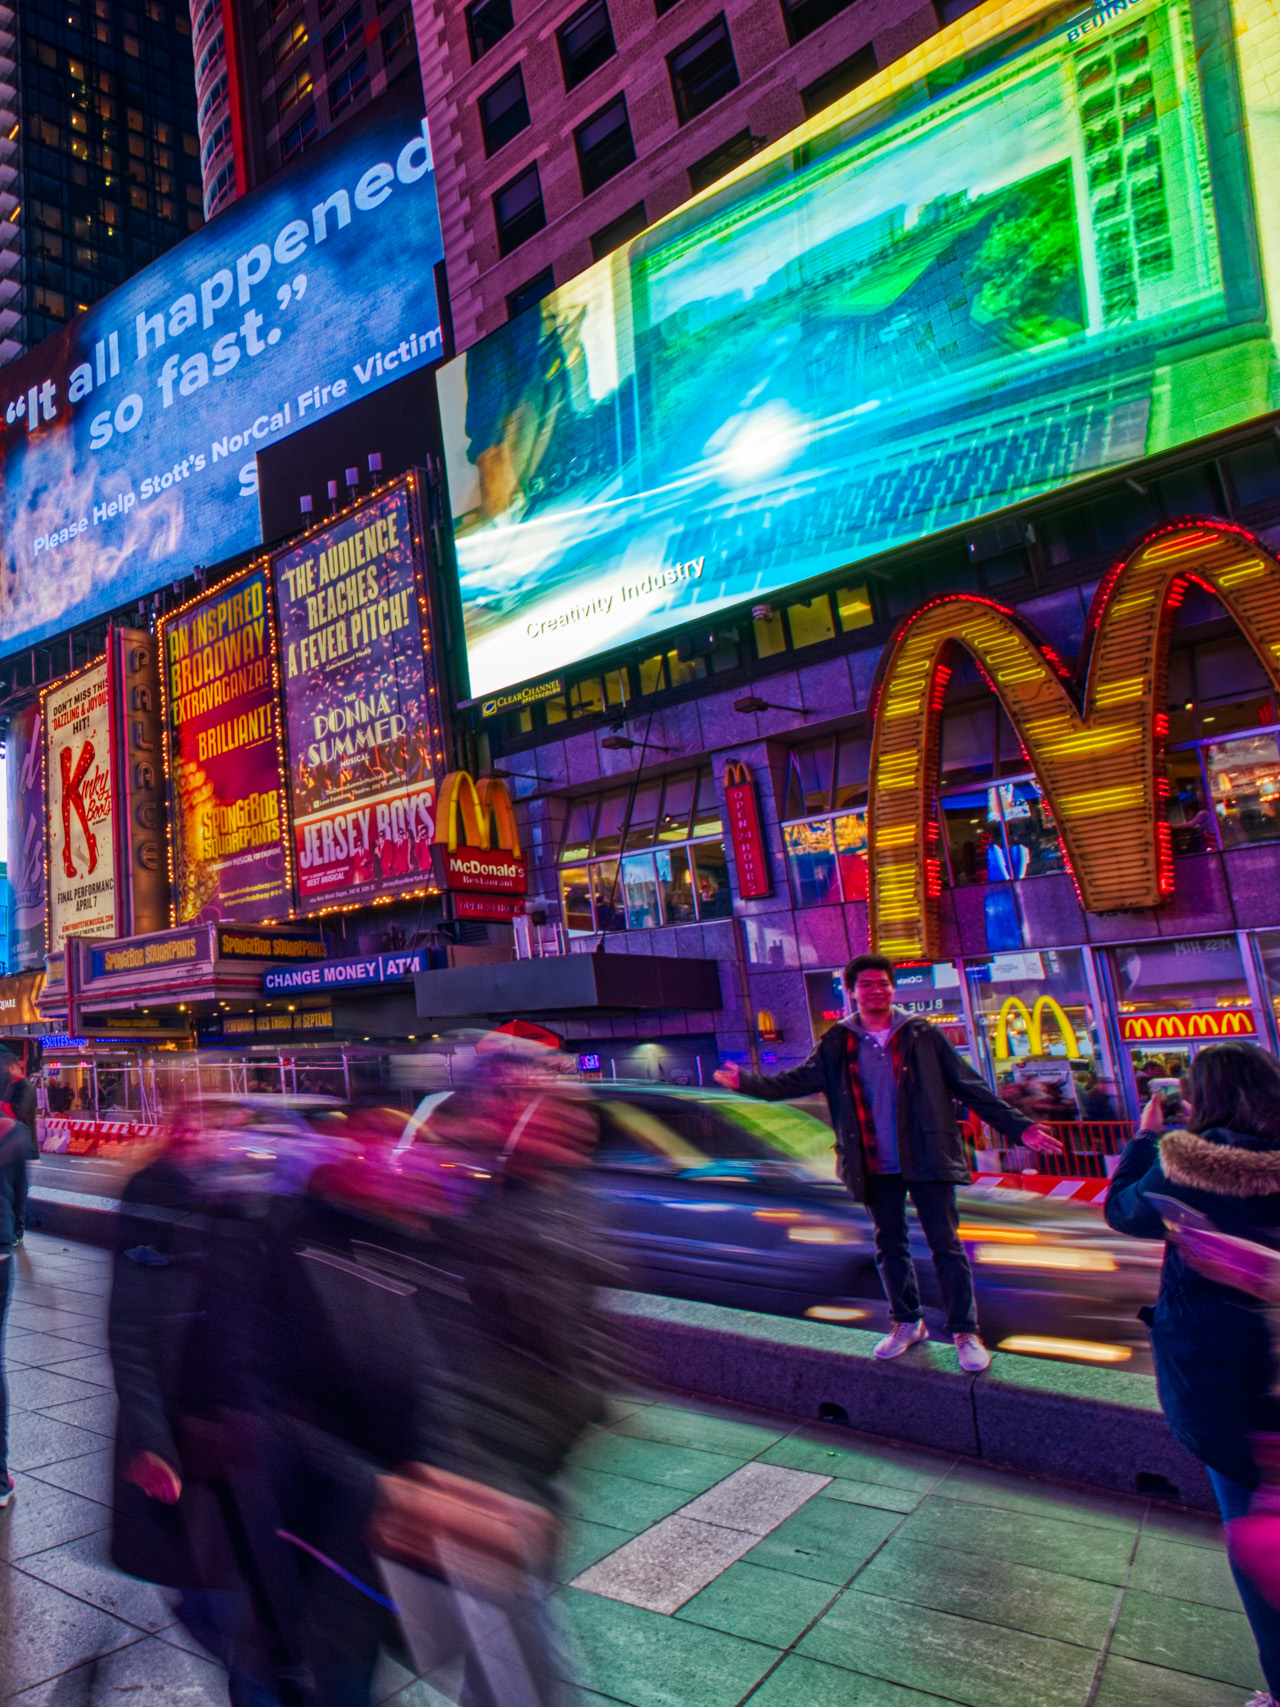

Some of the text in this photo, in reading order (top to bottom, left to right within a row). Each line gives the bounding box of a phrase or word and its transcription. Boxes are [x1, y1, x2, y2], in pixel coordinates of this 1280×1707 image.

[69, 331, 120, 402] all
[136, 118, 434, 360] happened
[90, 394, 143, 450] so
[34, 519, 88, 556] Please
[93, 492, 135, 525] Help
[212, 407, 291, 457] NorCal
[297, 377, 347, 419] Fire
[319, 512, 399, 587] AUDIENCE
[192, 581, 264, 650] INSPIRED
[307, 565, 379, 630] REACHES
[526, 556, 706, 640] Creativity Industry
[171, 617, 265, 700] BROADWAY
[288, 644, 298, 678] A
[300, 620, 348, 672] FEVER
[74, 687, 91, 705] MISS
[81, 703, 86, 716] &
[314, 691, 391, 740] DONNA
[343, 692, 357, 703] THE
[522, 687, 561, 704] SPECTACOLOR
[73, 716, 89, 734] HIT!
[308, 714, 406, 767] SUMMER
[131, 646, 158, 870] PALACE
[340, 753, 370, 768] MUSICAL
[376, 791, 435, 843] BOYS
[734, 791, 748, 828] OPEN
[300, 807, 370, 869] JERSEY
[737, 831, 752, 840] 24
[307, 878, 320, 887] BEST
[321, 872, 345, 885] MUSICAL
[450, 859, 524, 878] McDonald's
[742, 843, 757, 892] HOURS
[58, 890, 73, 904] FINAL
[76, 896, 97, 912] APRIL 7
[460, 902, 483, 911] OPEN
[266, 956, 420, 988] CHANGE MONEY ATM
[44, 1034, 69, 1047] SUITES
